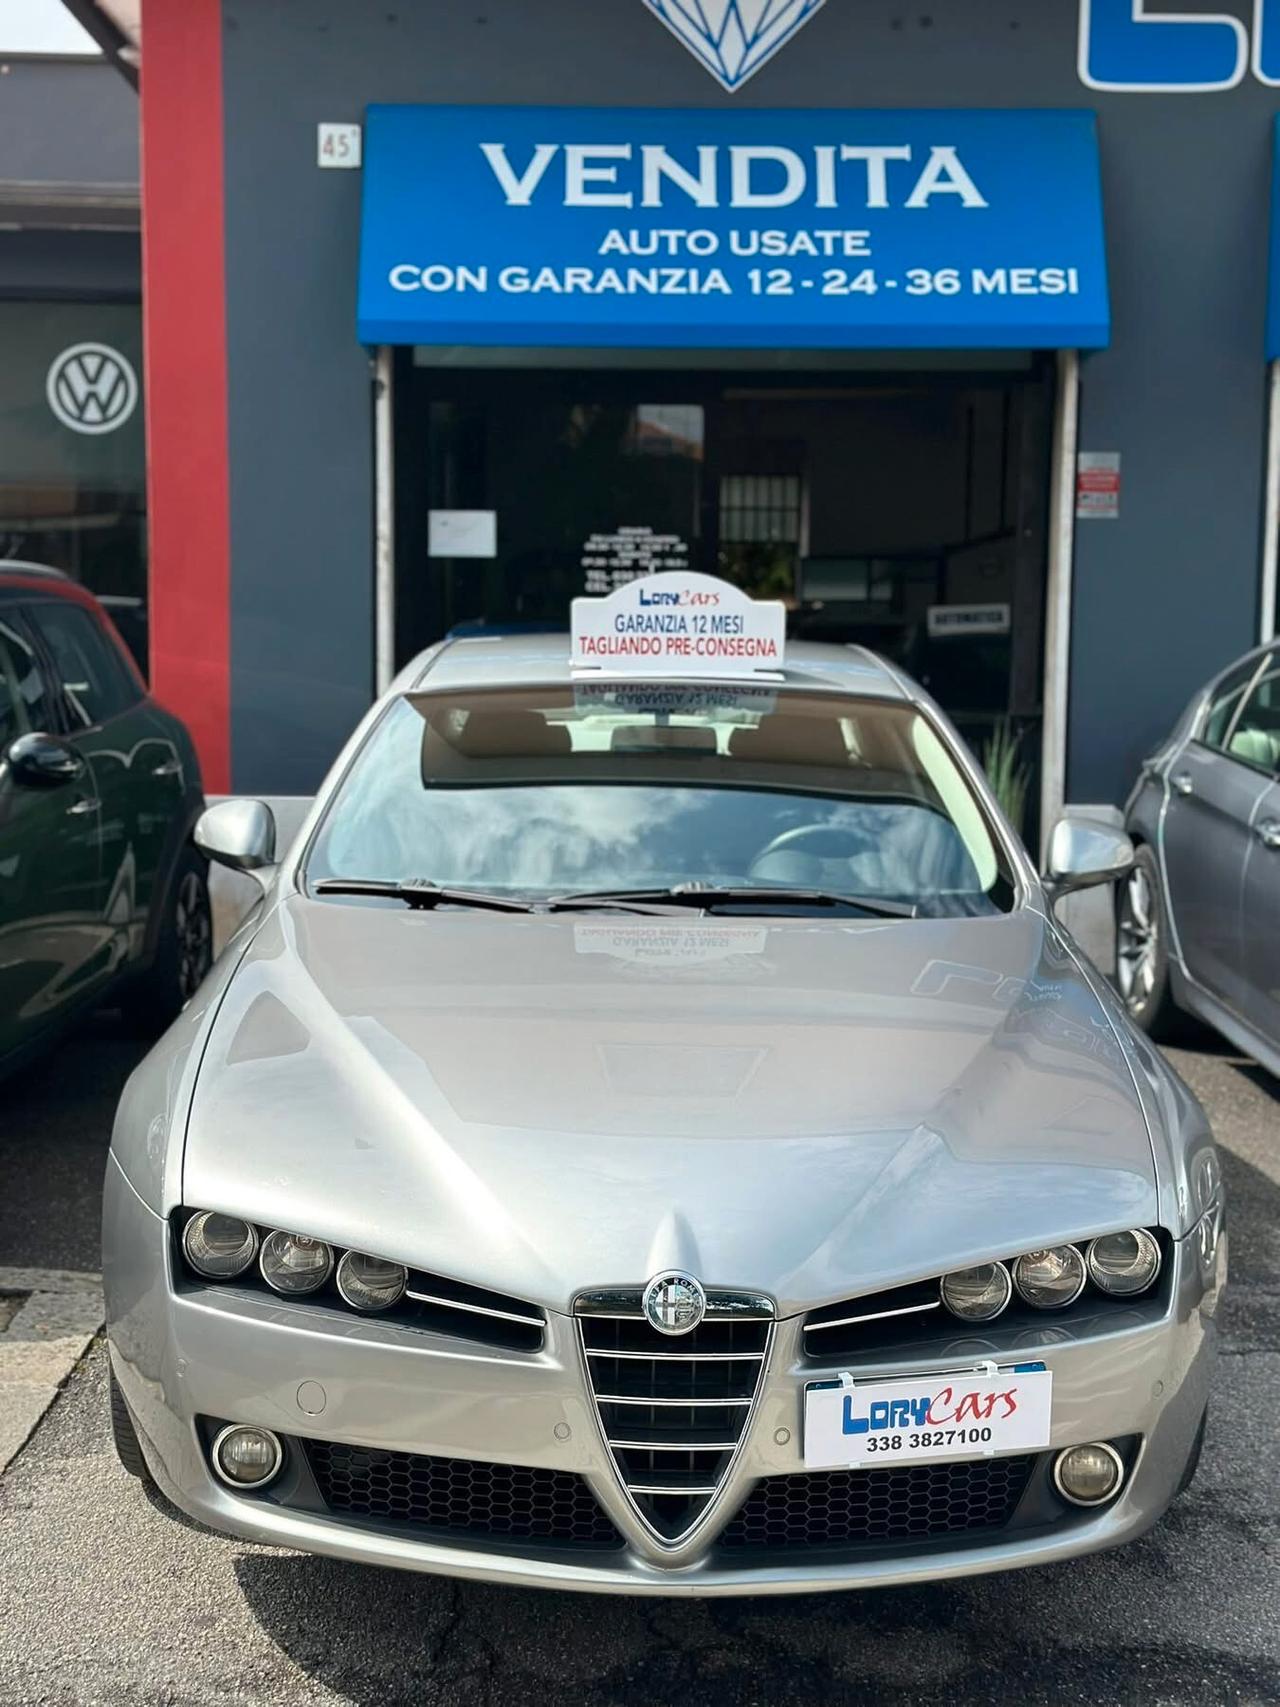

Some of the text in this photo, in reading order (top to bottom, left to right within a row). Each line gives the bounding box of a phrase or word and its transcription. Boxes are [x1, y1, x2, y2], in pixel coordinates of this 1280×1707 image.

[480, 143, 988, 208] VENDITA
[598, 229, 872, 256] AUTO USATE
[388, 264, 487, 293] CON
[498, 266, 732, 295] GARANZIA
[748, 268, 794, 295] 12
[821, 269, 878, 295] 24
[904, 269, 961, 295] 36
[971, 268, 1079, 295] MESI
[614, 614, 744, 634] GARANZIA 12 MESI
[579, 635, 778, 657] TAGLIANDO PRE-CONSEGNA
[648, 1277, 701, 1307] ALFA ROMEO
[866, 1427, 992, 1452] 338 3827100
